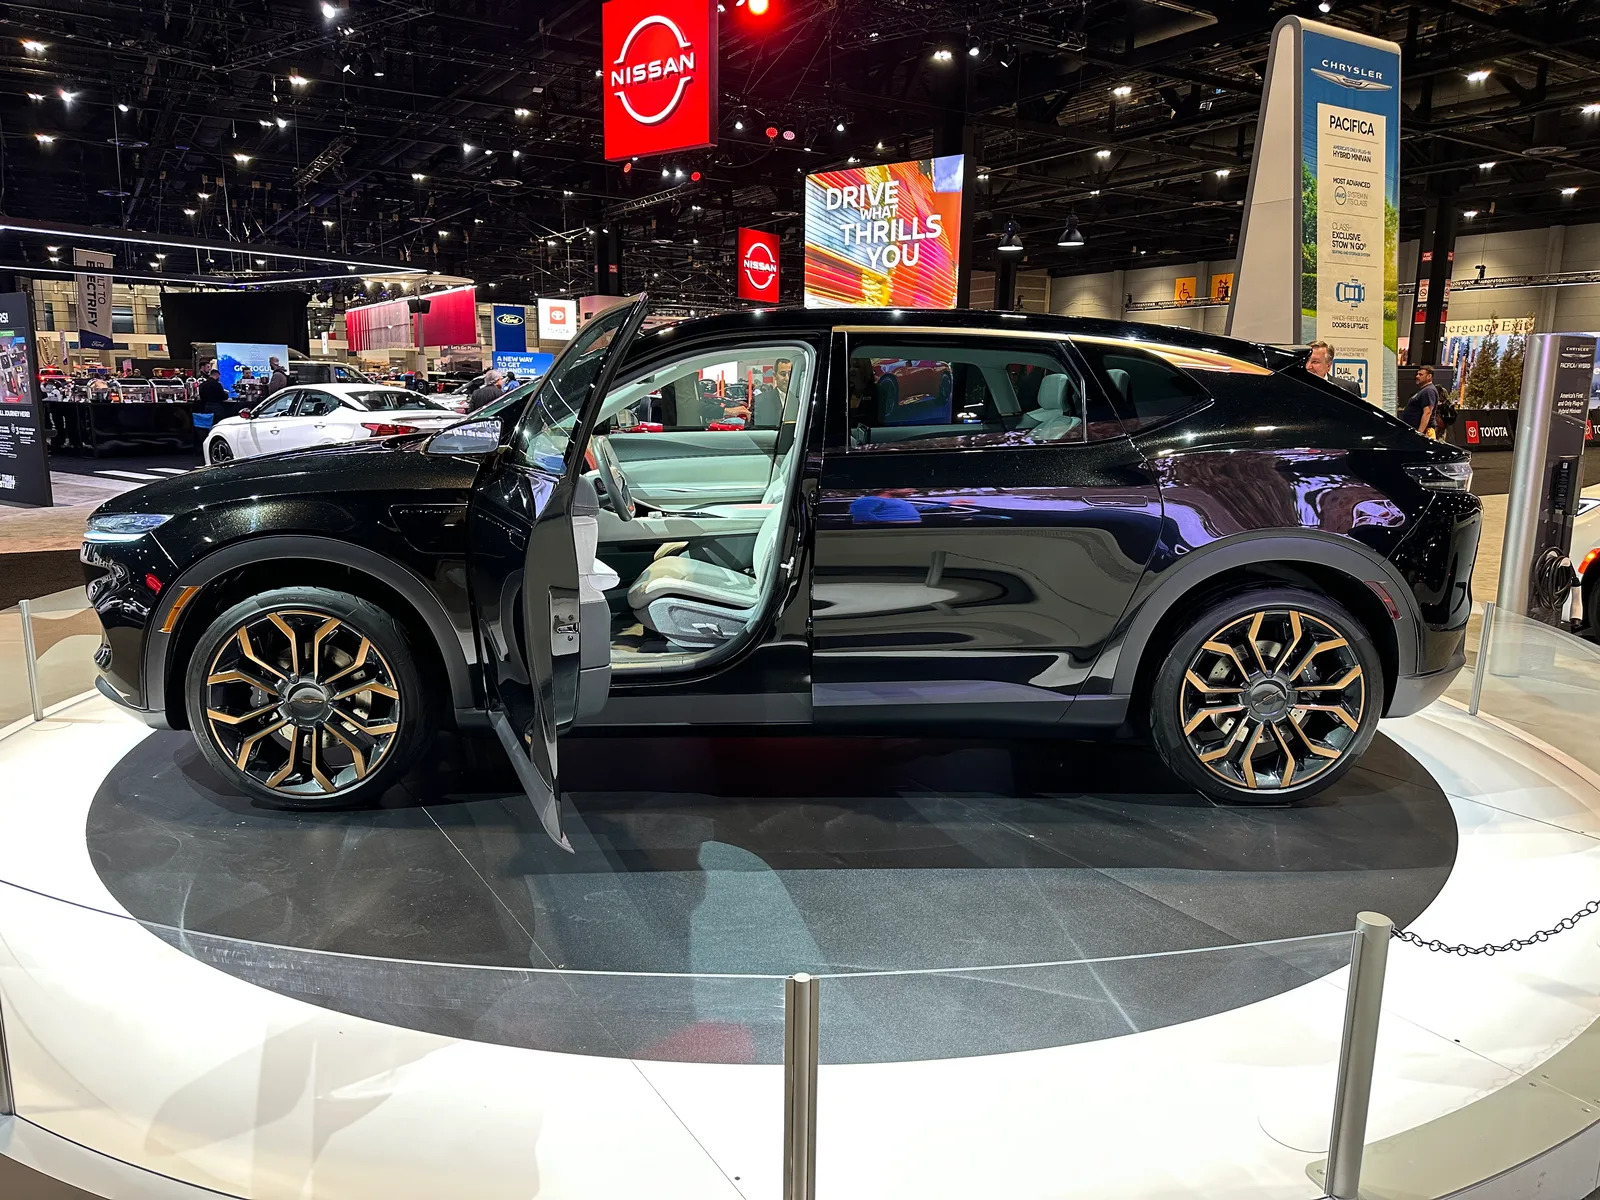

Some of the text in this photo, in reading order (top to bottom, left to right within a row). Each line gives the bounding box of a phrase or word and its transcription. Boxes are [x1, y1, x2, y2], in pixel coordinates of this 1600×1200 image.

[611, 52, 694, 87] NISSAN
[1321, 59, 1383, 80] CHRYSLER
[1329, 114, 1375, 136] PACIFICA
[1333, 150, 1371, 163] HYBRID MINIVAN
[1346, 180, 1371, 188] ADVANCED
[826, 180, 900, 211] DRIVE
[1347, 191, 1362, 199] SYSTEM
[860, 204, 898, 220] WHAT
[840, 214, 942, 246] THRILLS
[1332, 231, 1361, 242] EXCLUSIVE
[1332, 240, 1348, 249] STOW
[866, 243, 920, 270] YOU
[744, 260, 776, 272] NISSAN
[96, 262, 106, 305] BILT TO
[86, 260, 98, 328] EECTRIFY
[502, 314, 519, 324] Ford
[1445, 323, 1498, 335] ergency
[1480, 427, 1508, 437] TOYOTA
